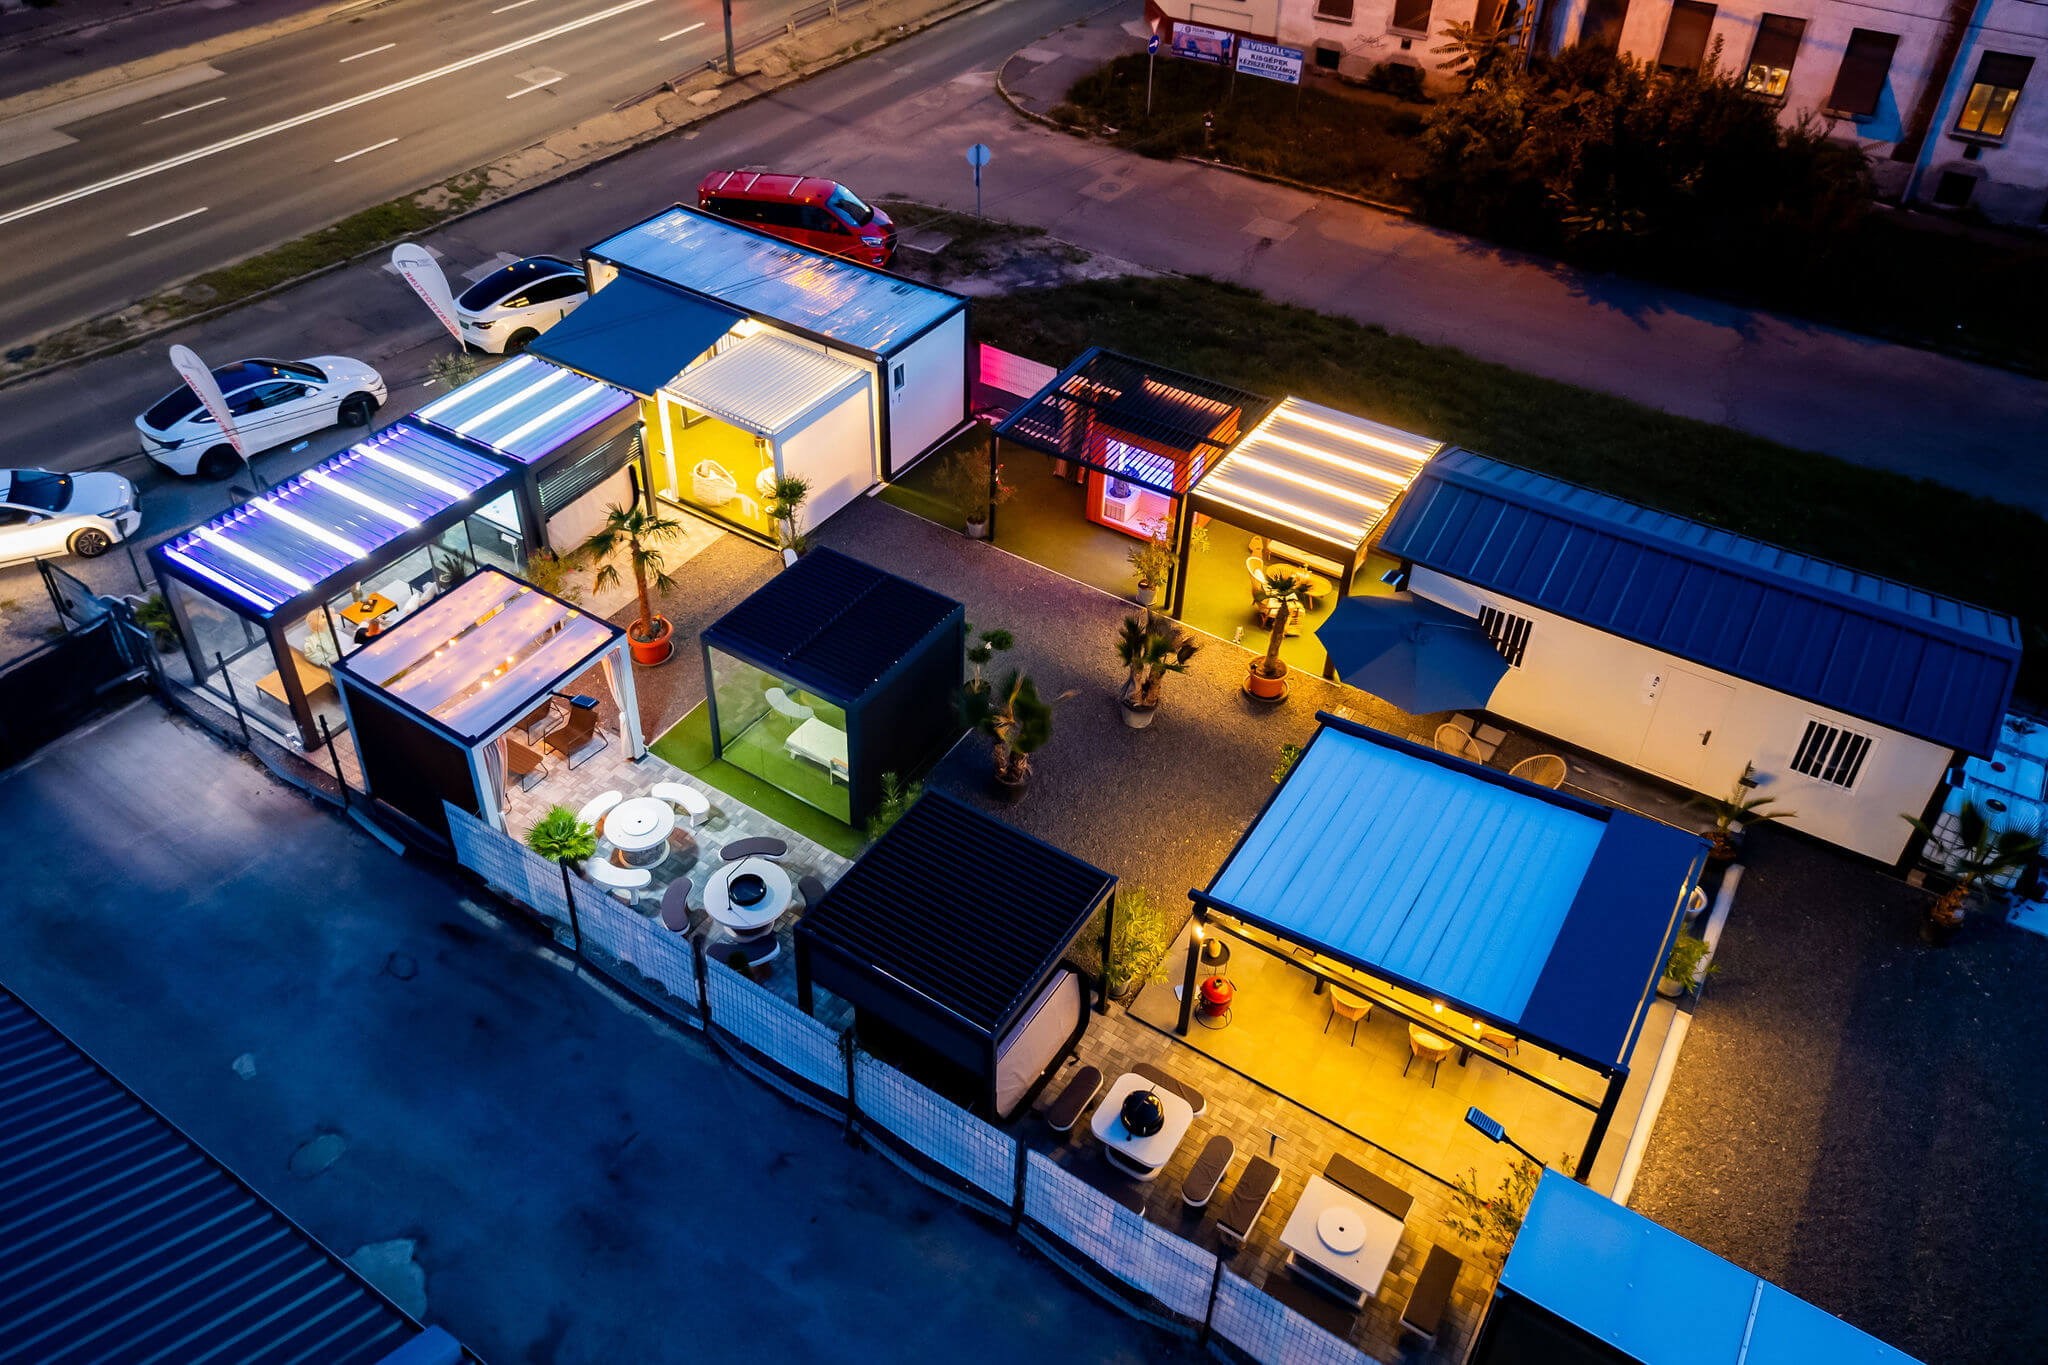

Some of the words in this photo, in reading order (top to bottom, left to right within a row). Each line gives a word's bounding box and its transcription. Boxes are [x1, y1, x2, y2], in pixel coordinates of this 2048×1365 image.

[1251, 42, 1286, 56] VASVILL
[1239, 57, 1297, 75] KÉZISZERSZÁMOK
[1250, 53, 1289, 67] KISGÉPEK
